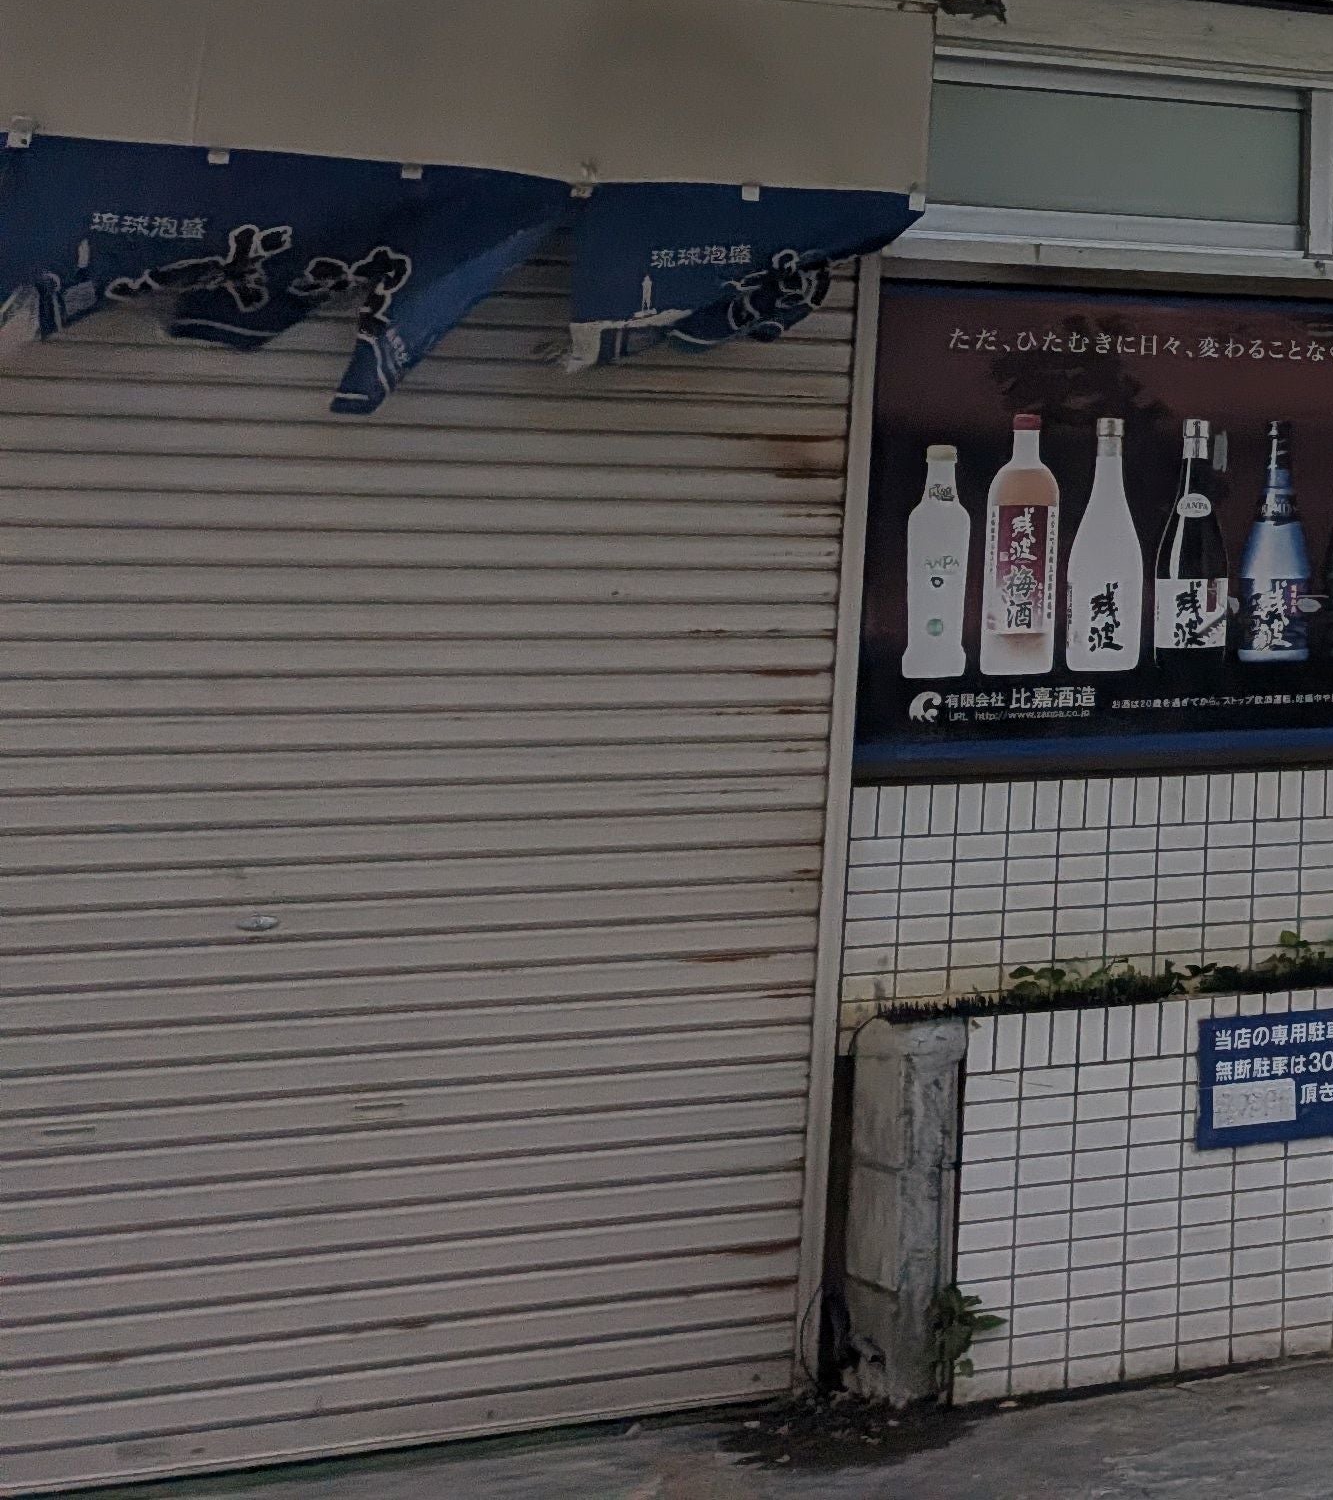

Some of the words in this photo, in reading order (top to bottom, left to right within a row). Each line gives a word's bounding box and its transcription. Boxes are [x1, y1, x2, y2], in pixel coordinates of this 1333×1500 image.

[1089, 582, 1124, 652] 残波
[945, 692, 1006, 709] 有限会社
[1009, 686, 1096, 709] 比嘉酒造
